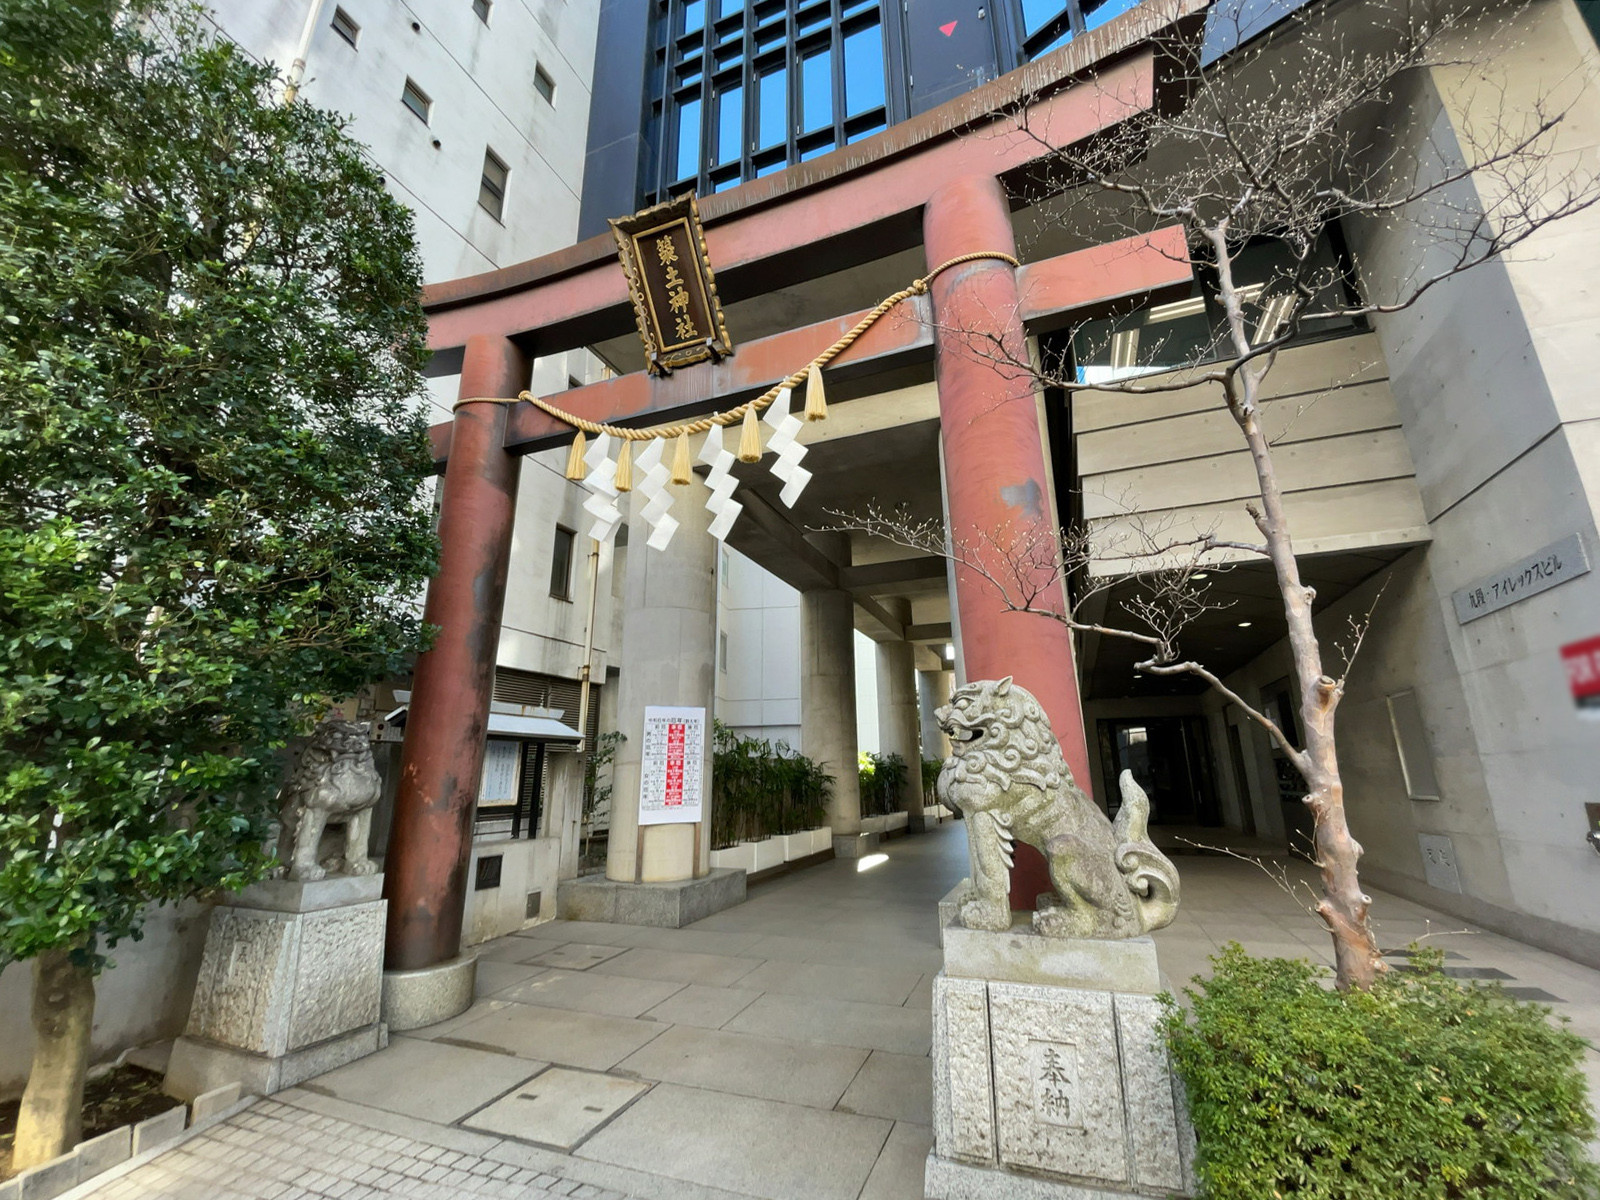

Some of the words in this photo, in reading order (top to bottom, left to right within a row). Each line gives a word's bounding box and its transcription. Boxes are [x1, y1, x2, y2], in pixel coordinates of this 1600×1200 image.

[656, 235, 698, 340] 築土神社
[1039, 1048, 1072, 1120] 奉納
